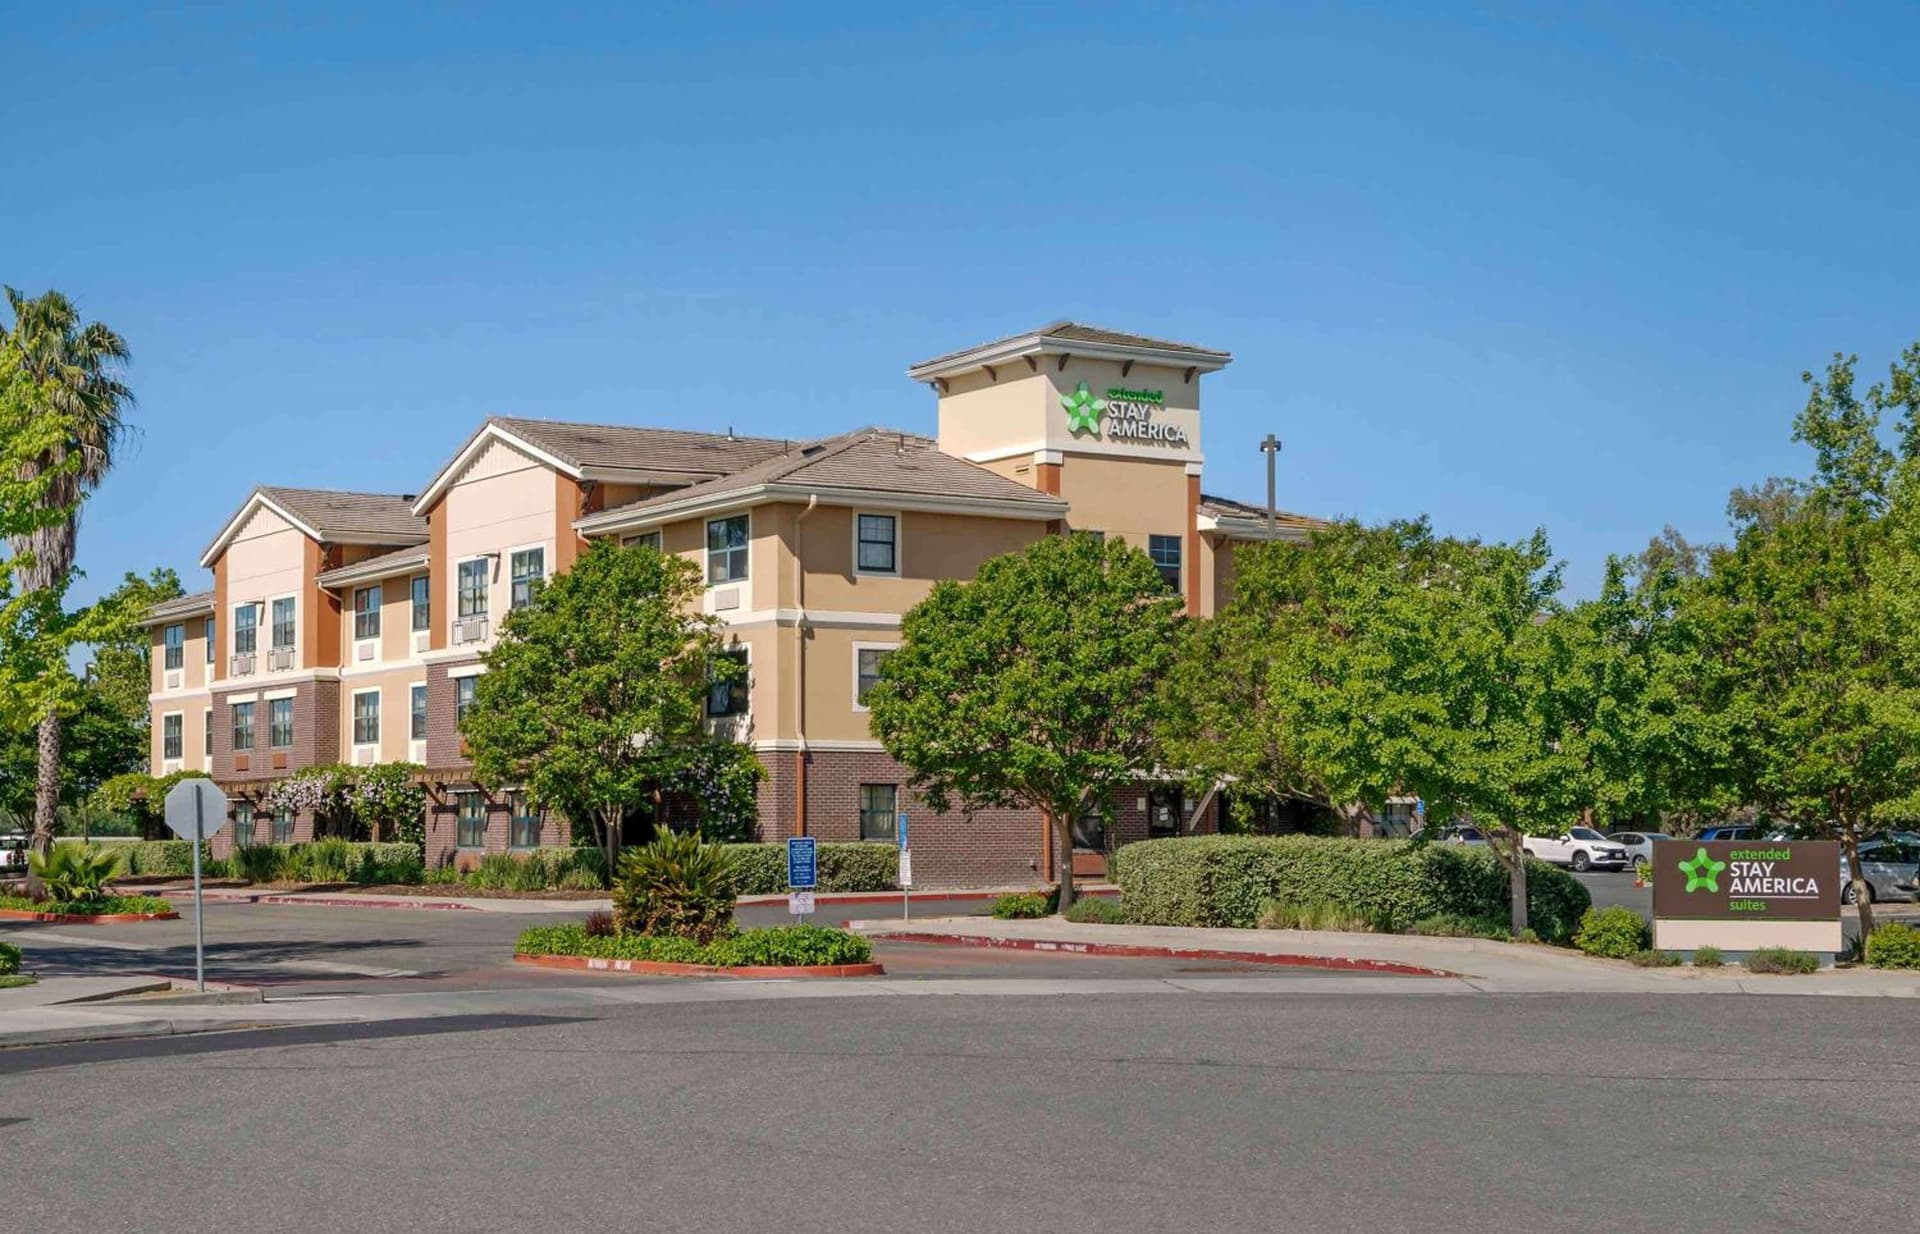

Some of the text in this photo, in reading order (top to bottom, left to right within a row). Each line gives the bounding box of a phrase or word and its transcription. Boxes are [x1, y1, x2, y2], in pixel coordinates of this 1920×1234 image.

[1108, 401, 1149, 419] STAY
[1109, 420, 1188, 443] AMERICA
[1730, 848, 1791, 860] extended
[1730, 861, 1775, 877] STAY
[1729, 878, 1819, 893] AMERICA
[1730, 899, 1767, 911] suites
